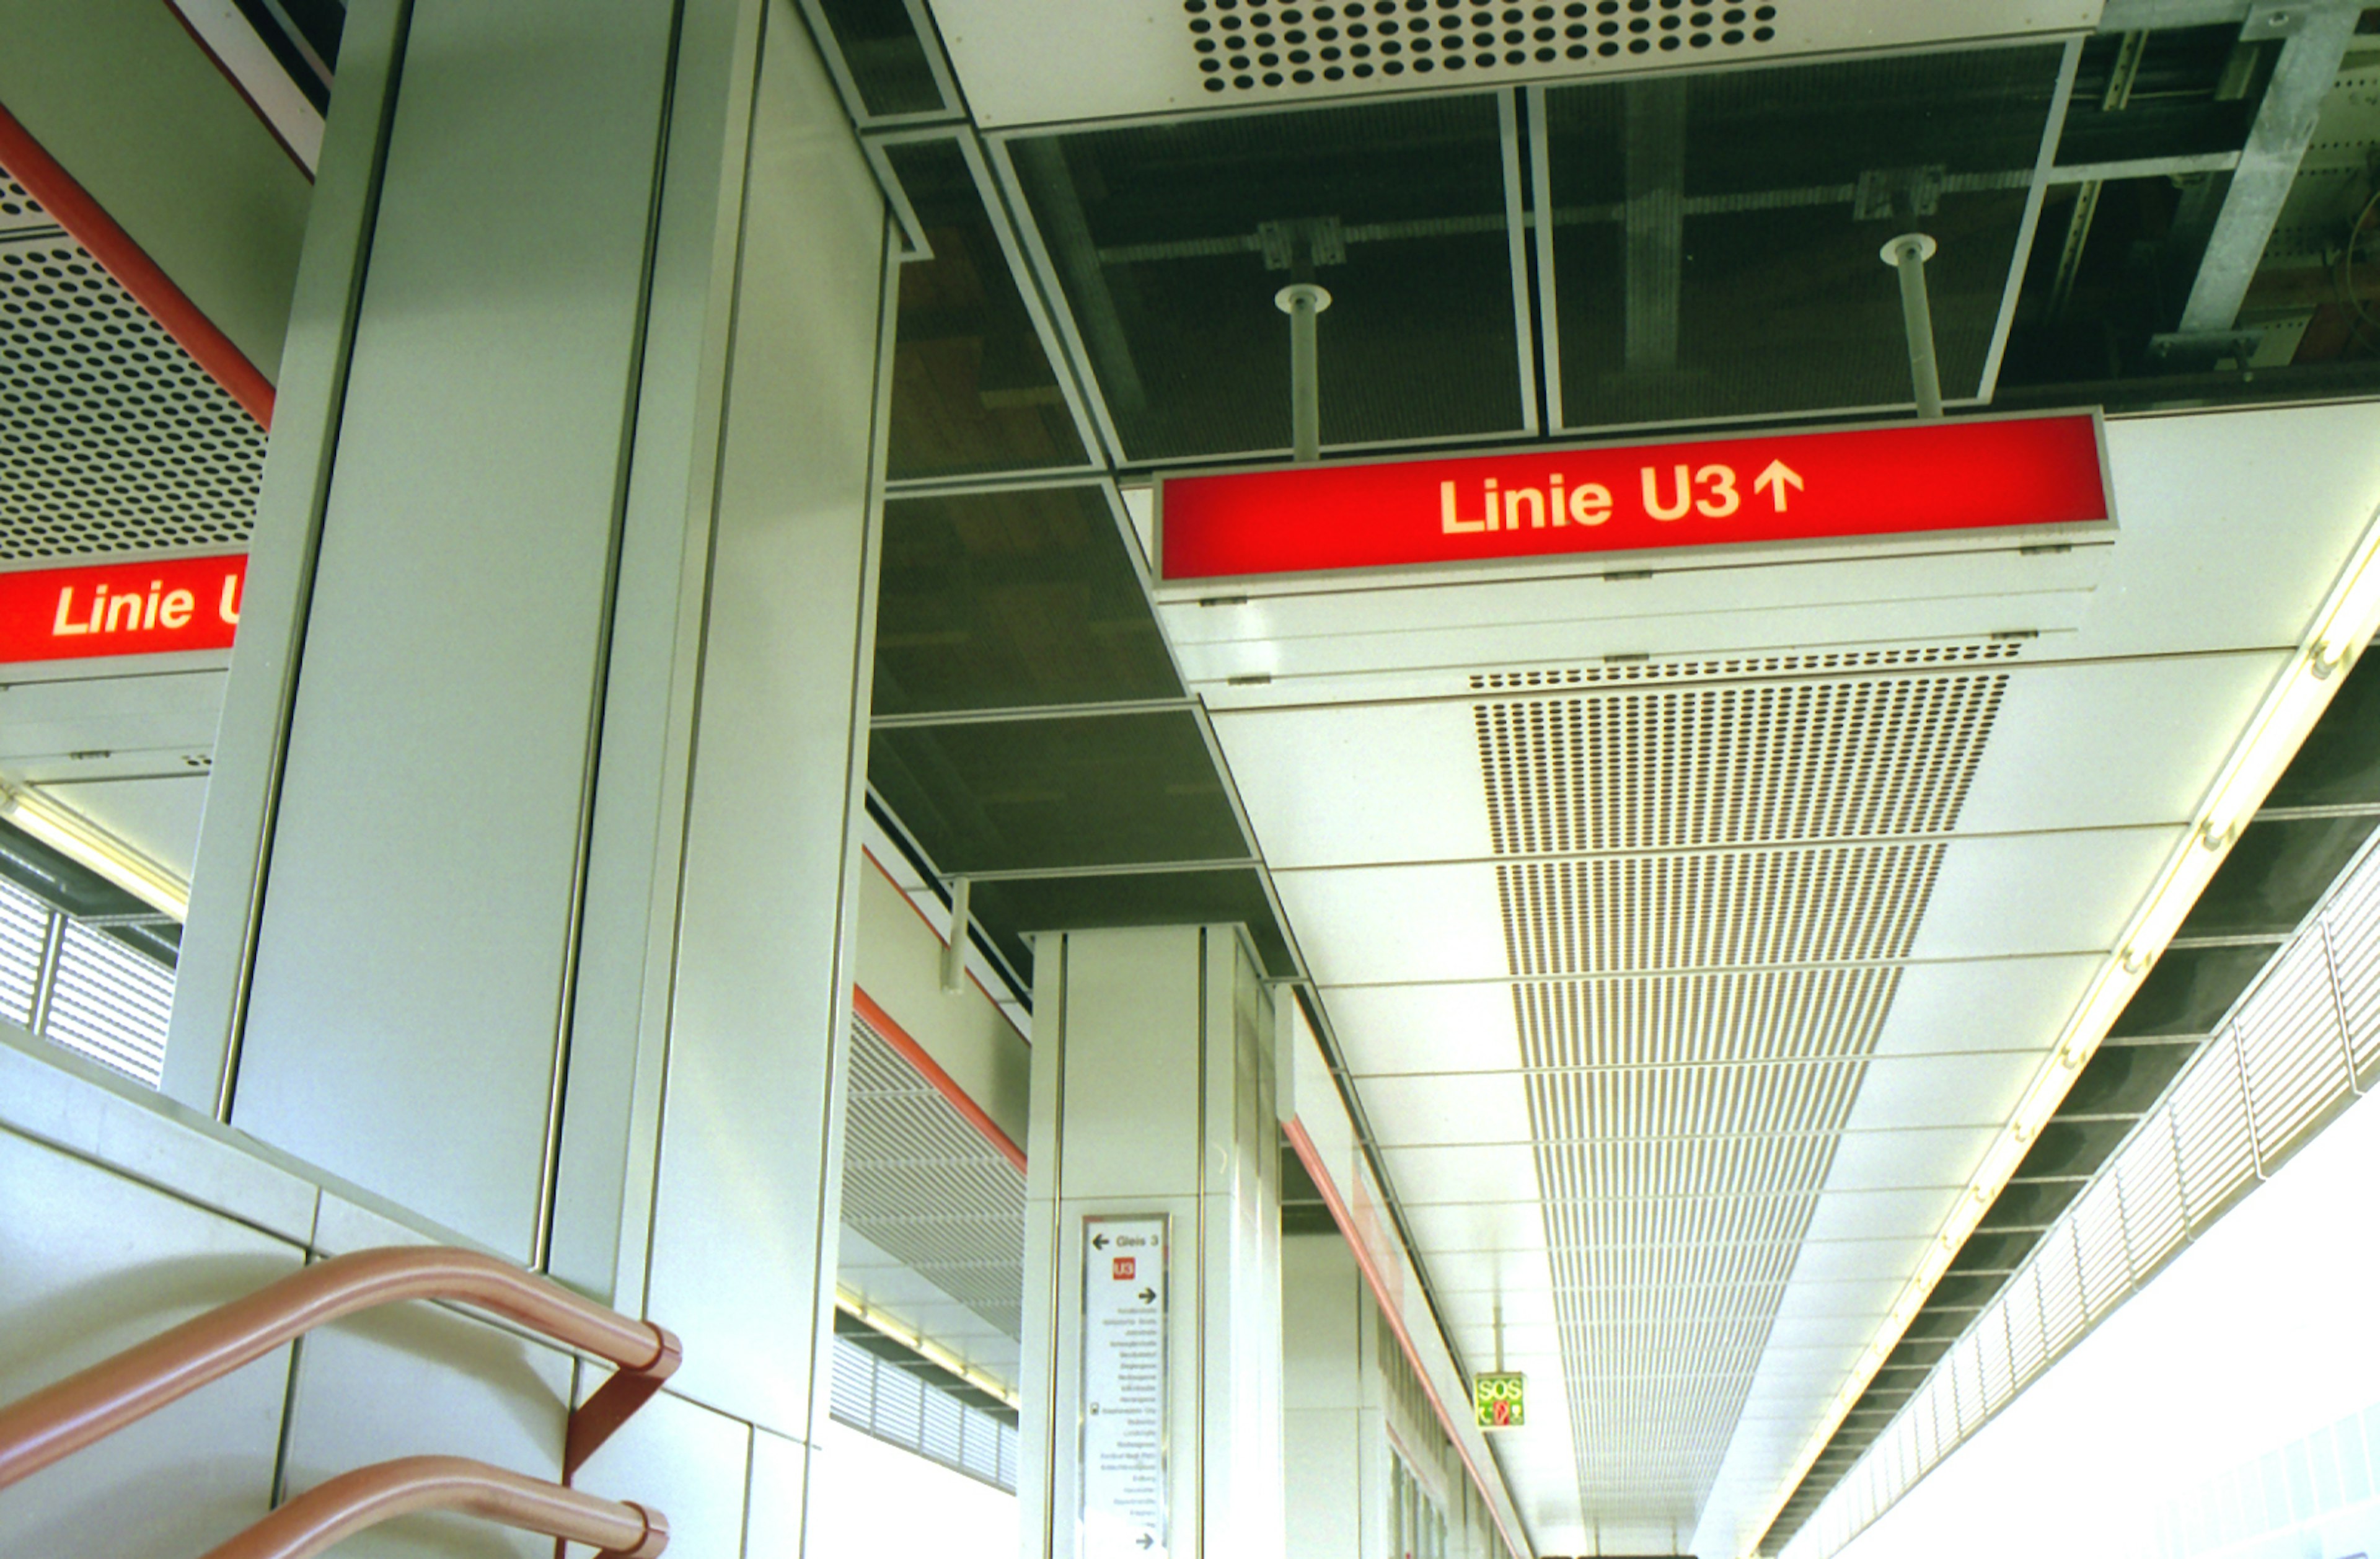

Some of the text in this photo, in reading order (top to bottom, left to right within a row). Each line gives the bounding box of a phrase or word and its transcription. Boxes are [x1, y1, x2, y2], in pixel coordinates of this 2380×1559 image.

[1440, 464, 1740, 534] Linie U3
[52, 579, 195, 636] Linie
[1116, 1234, 1159, 1247] Gleis 3
[1114, 1262, 1134, 1276] U3
[1479, 1379, 1522, 1401] SOS
